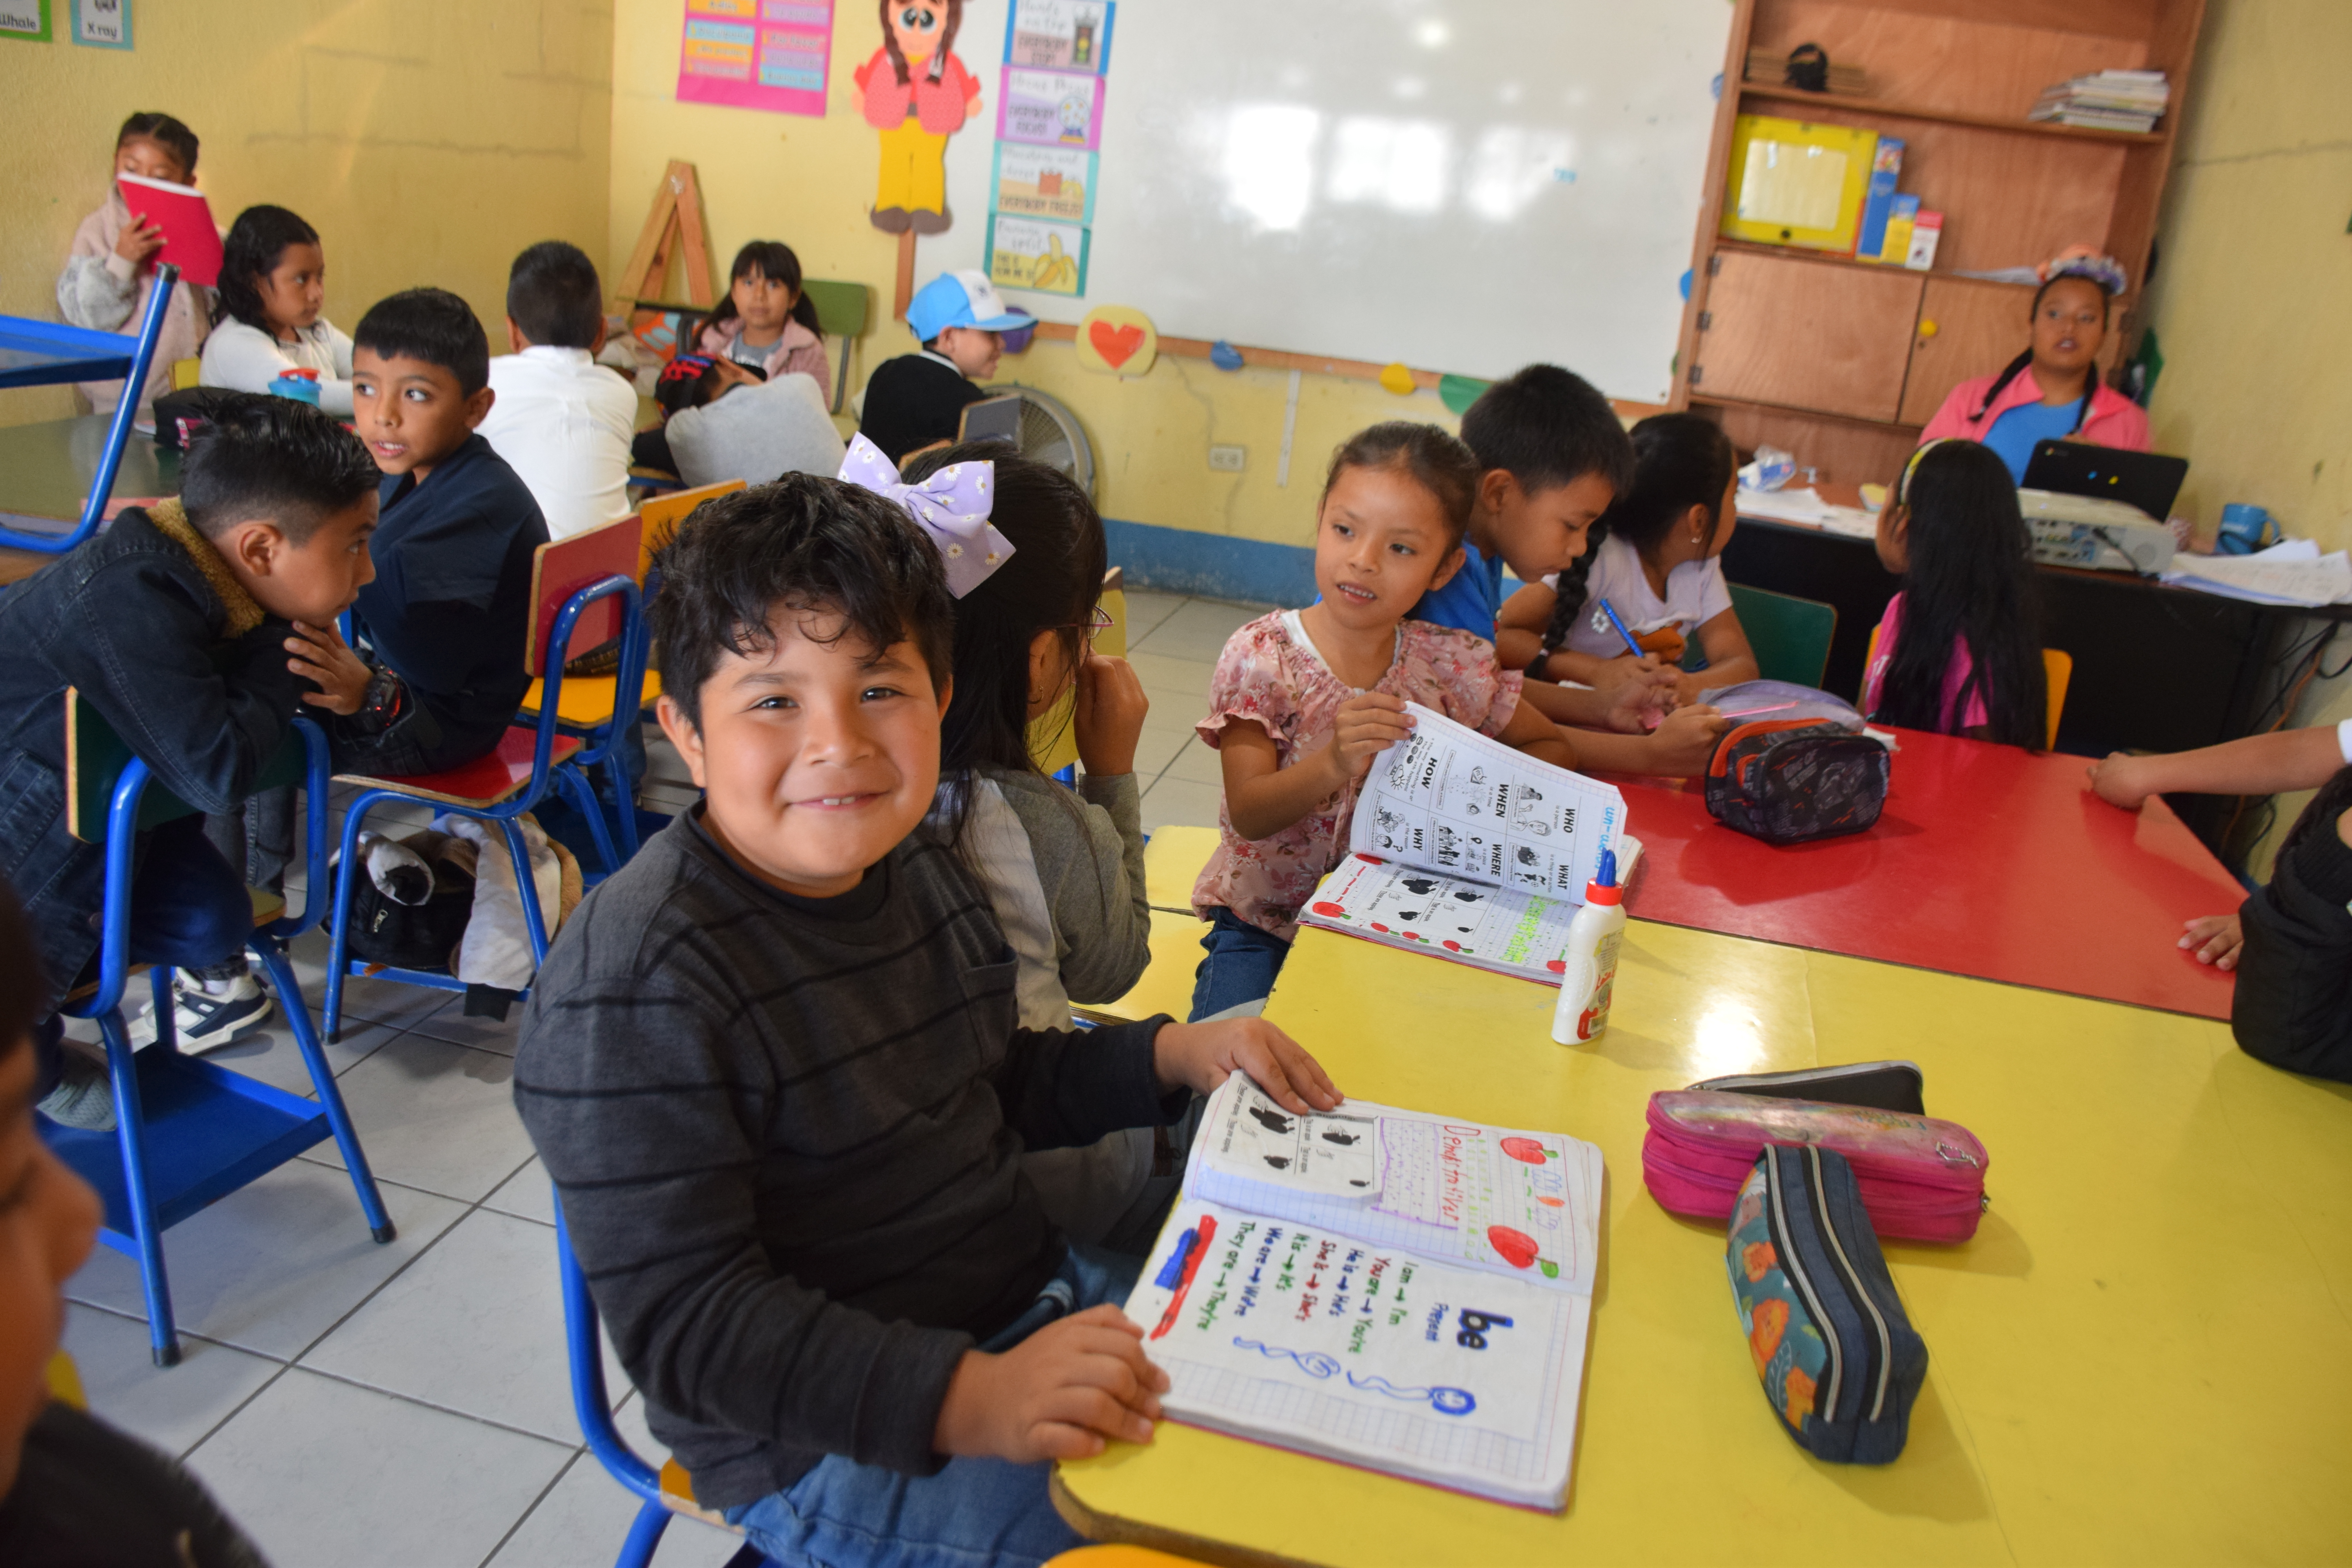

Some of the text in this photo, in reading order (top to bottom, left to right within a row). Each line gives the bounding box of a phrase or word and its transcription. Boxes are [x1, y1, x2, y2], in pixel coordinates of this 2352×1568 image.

[0, 15, 36, 30] Whale
[98, 25, 116, 39] ray
[1403, 771, 1413, 792] happens
[1412, 762, 1423, 789] something
[1421, 757, 1437, 789] HOW
[1495, 784, 1509, 818] WHEN
[1563, 808, 1575, 833] WHO
[1413, 828, 1423, 851] WHY
[1491, 844, 1502, 877] WHERE
[1557, 865, 1569, 889] WHAT
[1197, 1222, 1256, 1330] They are They're
[1234, 1227, 1283, 1317] We are We're
[1276, 1233, 1311, 1291] It is It's
[1400, 1268, 1414, 1283] am
[1294, 1240, 1336, 1322] She is She's
[1329, 1248, 1365, 1317] He is He's
[1348, 1257, 1392, 1354] You are You're
[1388, 1308, 1408, 1325] I'm
[1425, 1302, 1450, 1343] Present
[1456, 1307, 1514, 1350] be
